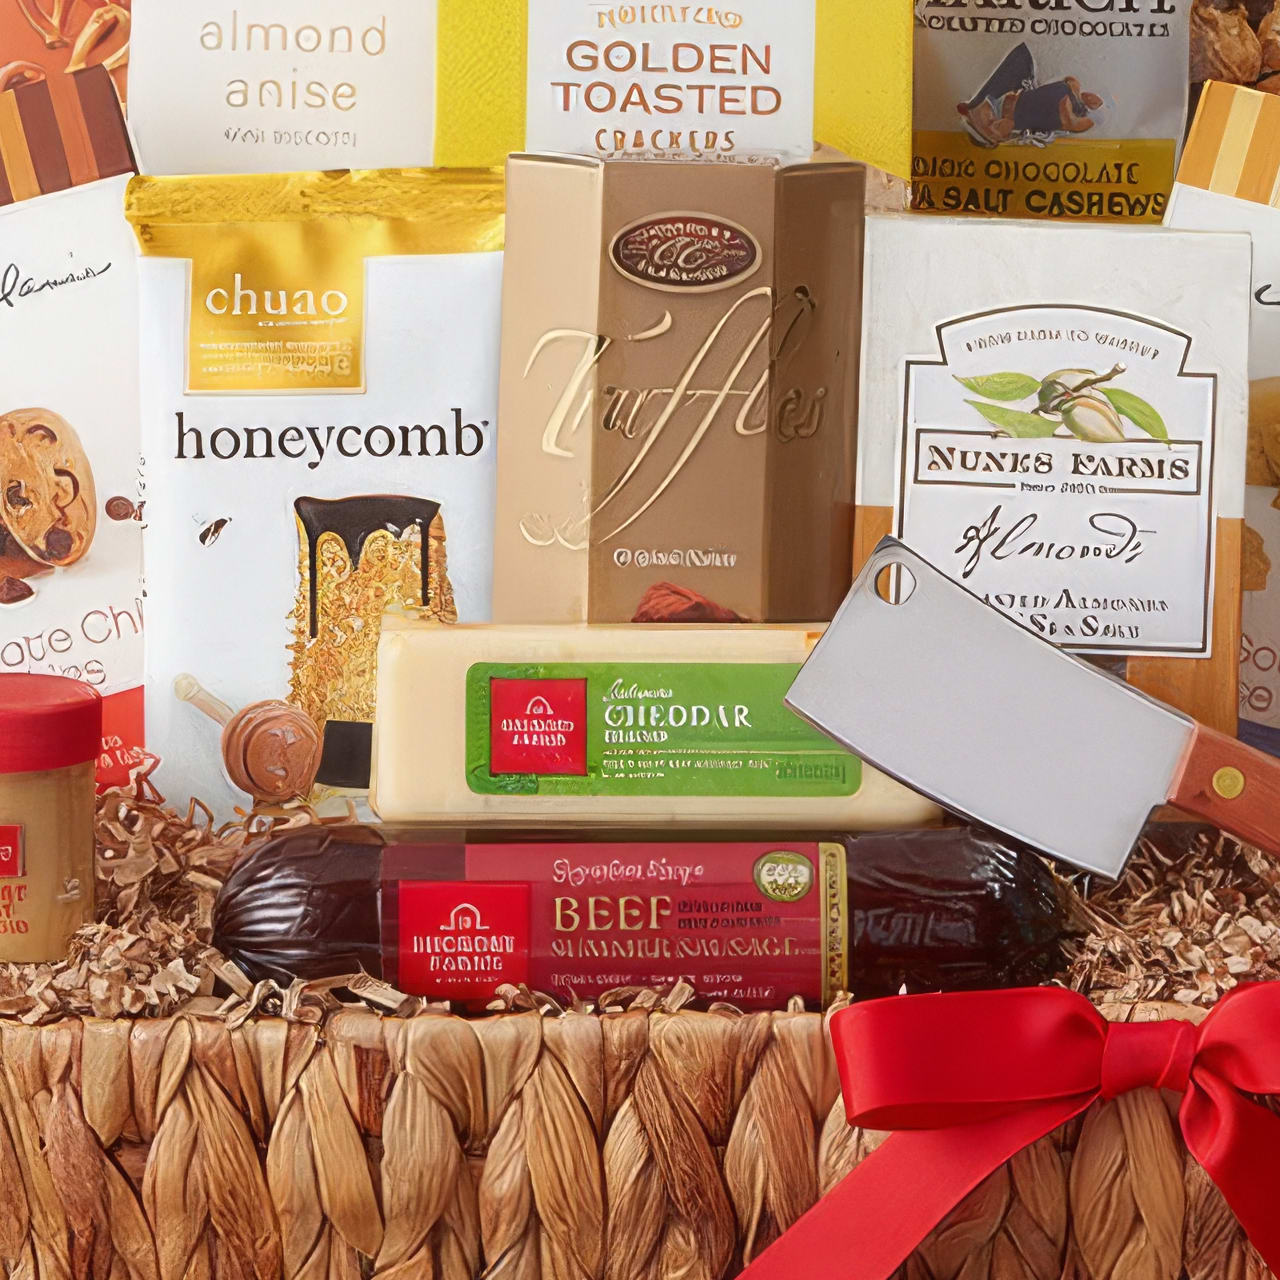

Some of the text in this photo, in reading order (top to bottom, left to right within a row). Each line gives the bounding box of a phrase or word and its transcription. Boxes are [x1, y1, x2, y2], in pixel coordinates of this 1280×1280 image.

[199, 9, 386, 57] almond
[565, 39, 771, 76] GOLDEN
[225, 67, 358, 112] anise
[549, 80, 782, 116] TOASTED
[942, 185, 1014, 214] SALT
[1024, 188, 1166, 217] CASHEWS
[205, 273, 349, 316] chuao
[174, 407, 485, 471] honeycomb
[553, 895, 672, 932] BEEF
